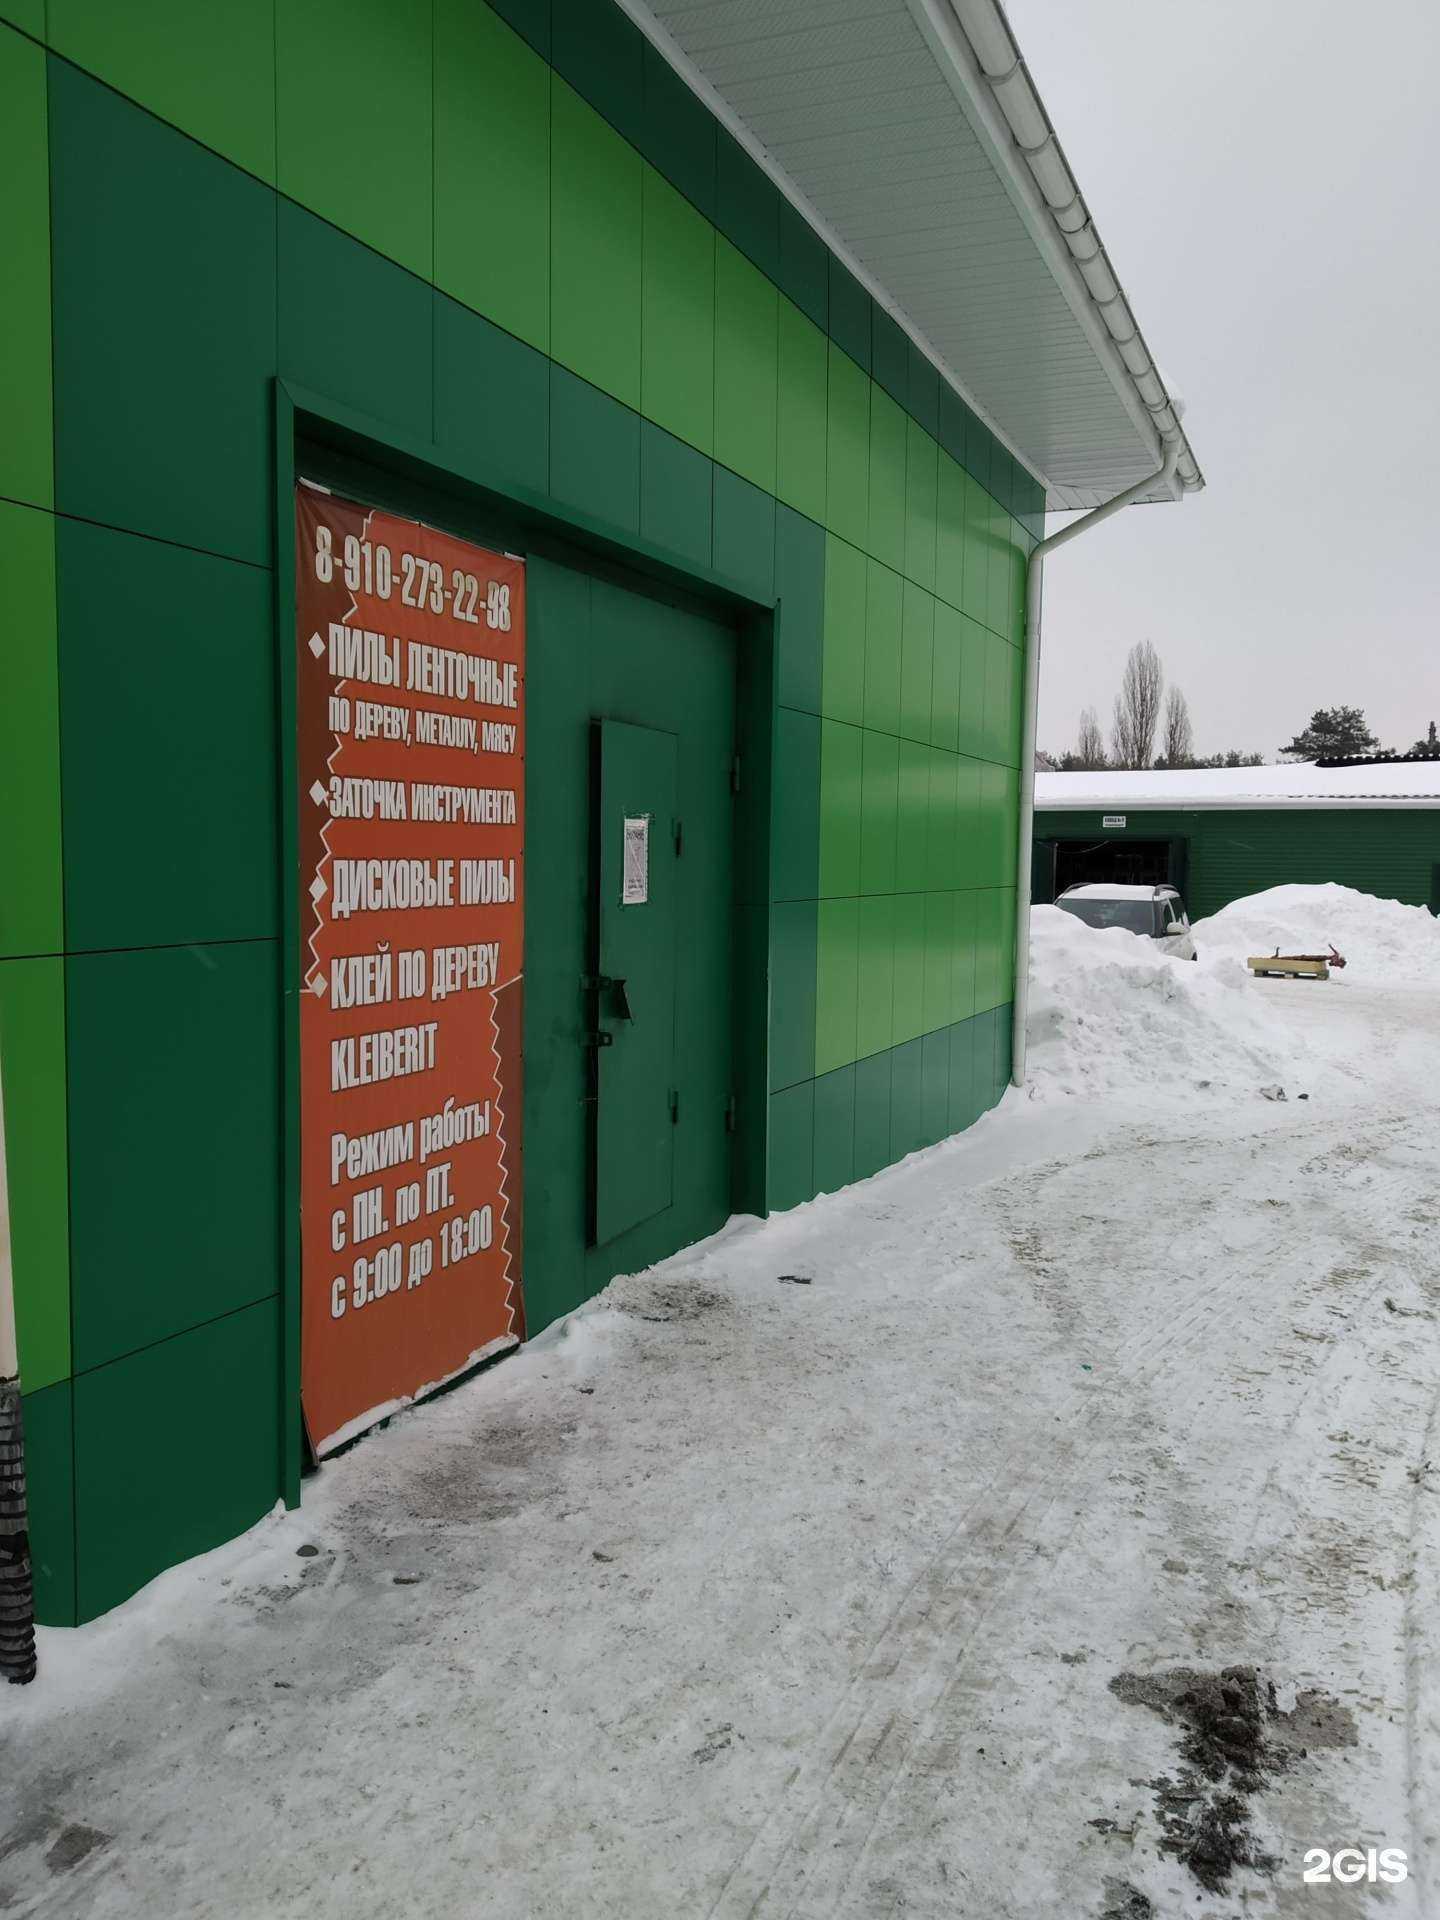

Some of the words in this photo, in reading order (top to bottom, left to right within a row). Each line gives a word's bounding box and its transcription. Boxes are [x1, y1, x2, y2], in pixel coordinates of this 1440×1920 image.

[315, 525, 511, 632] 8-910-273-22-98
[328, 622, 400, 689] ПИЛЫ
[407, 641, 518, 708] ЛЕНТОЧНЫЕ
[328, 696, 350, 733] ПО
[355, 701, 411, 746] ДЕРЕВУ,
[416, 711, 479, 755] МЕТАЛЛУ,
[482, 720, 516, 754] МЯСУ
[329, 776, 407, 821] ЗАТОЧКА
[411, 783, 516, 824] ИНСТРУМЕНТА
[331, 859, 454, 919] ДИСКОВЫЕ
[459, 859, 515, 906] ПИЛЫ
[330, 941, 392, 1010] КЛЕЙ
[398, 949, 426, 1000] ПО
[431, 942, 500, 1001] ДЕРЕВУ
[331, 1022, 438, 1091] KLEIBERIT
[331, 1121, 413, 1185] Режим
[419, 1097, 490, 1159] работы
[352, 1185, 388, 1245] ПН.
[395, 1185, 420, 1228] по
[426, 1162, 454, 1213] ПТ.
[352, 1242, 402, 1310] 9:00
[408, 1243, 432, 1289] до
[440, 1205, 493, 1270] 18:00
